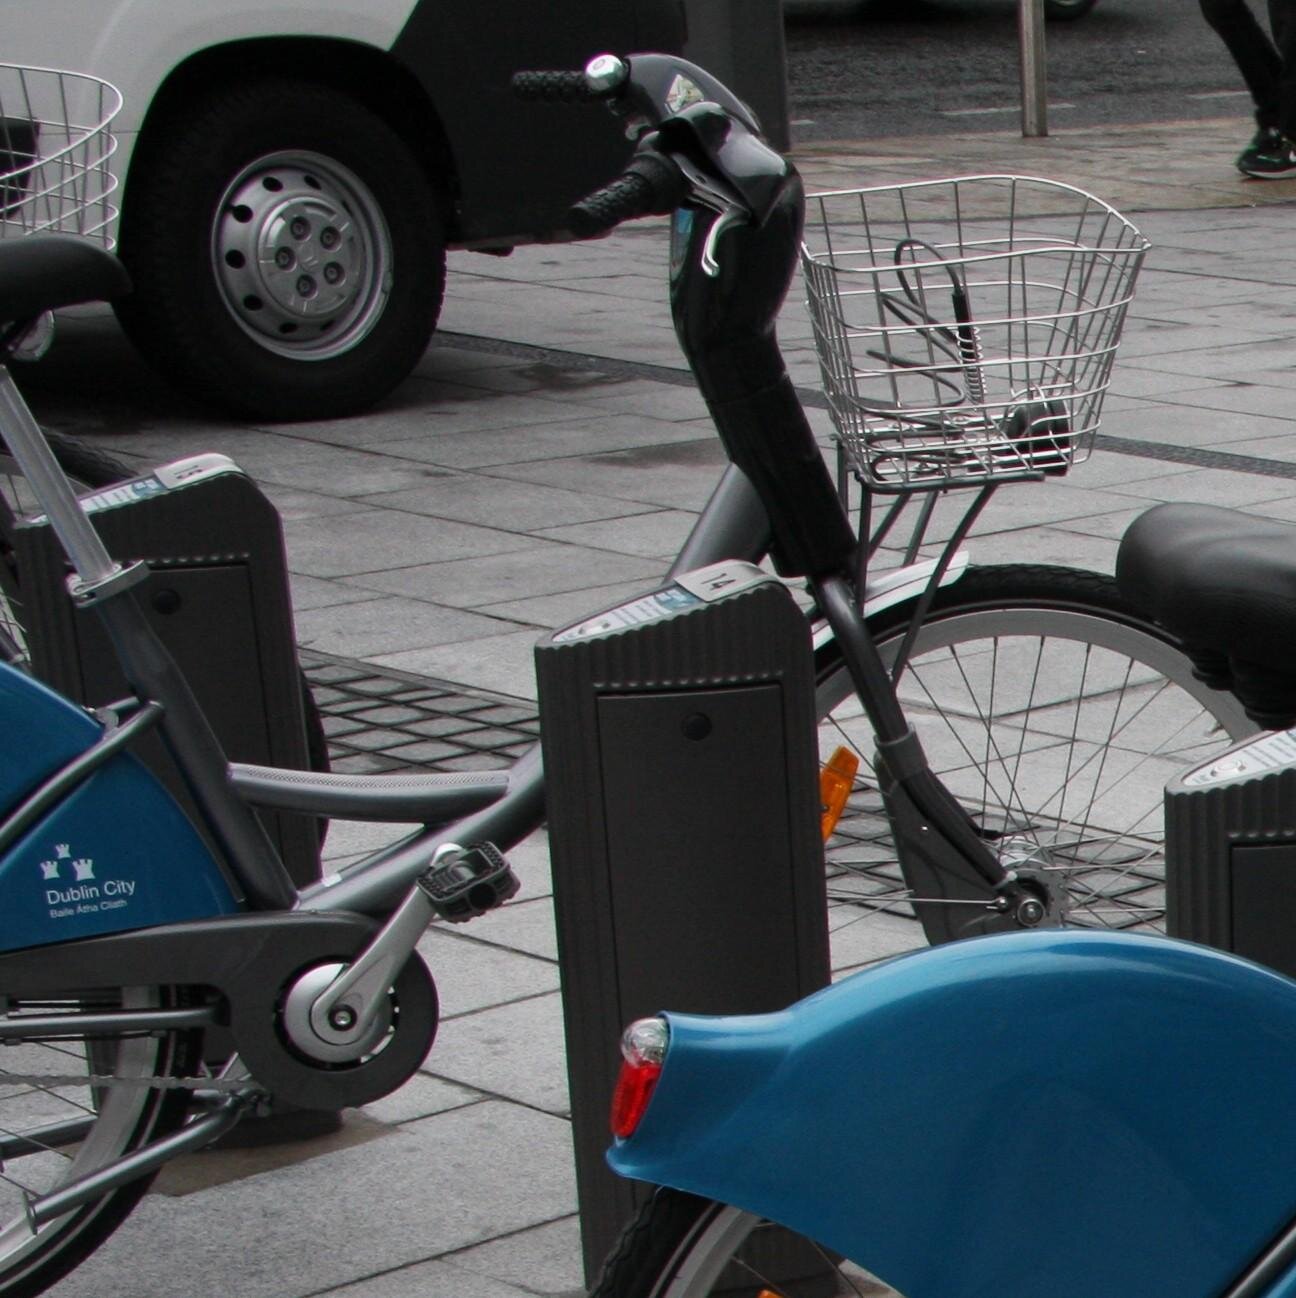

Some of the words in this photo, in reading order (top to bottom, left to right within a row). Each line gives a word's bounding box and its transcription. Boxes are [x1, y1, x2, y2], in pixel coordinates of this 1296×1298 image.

[700, 572, 737, 591] 14
[46, 885, 100, 904] Dublin
[104, 880, 135, 896] City
